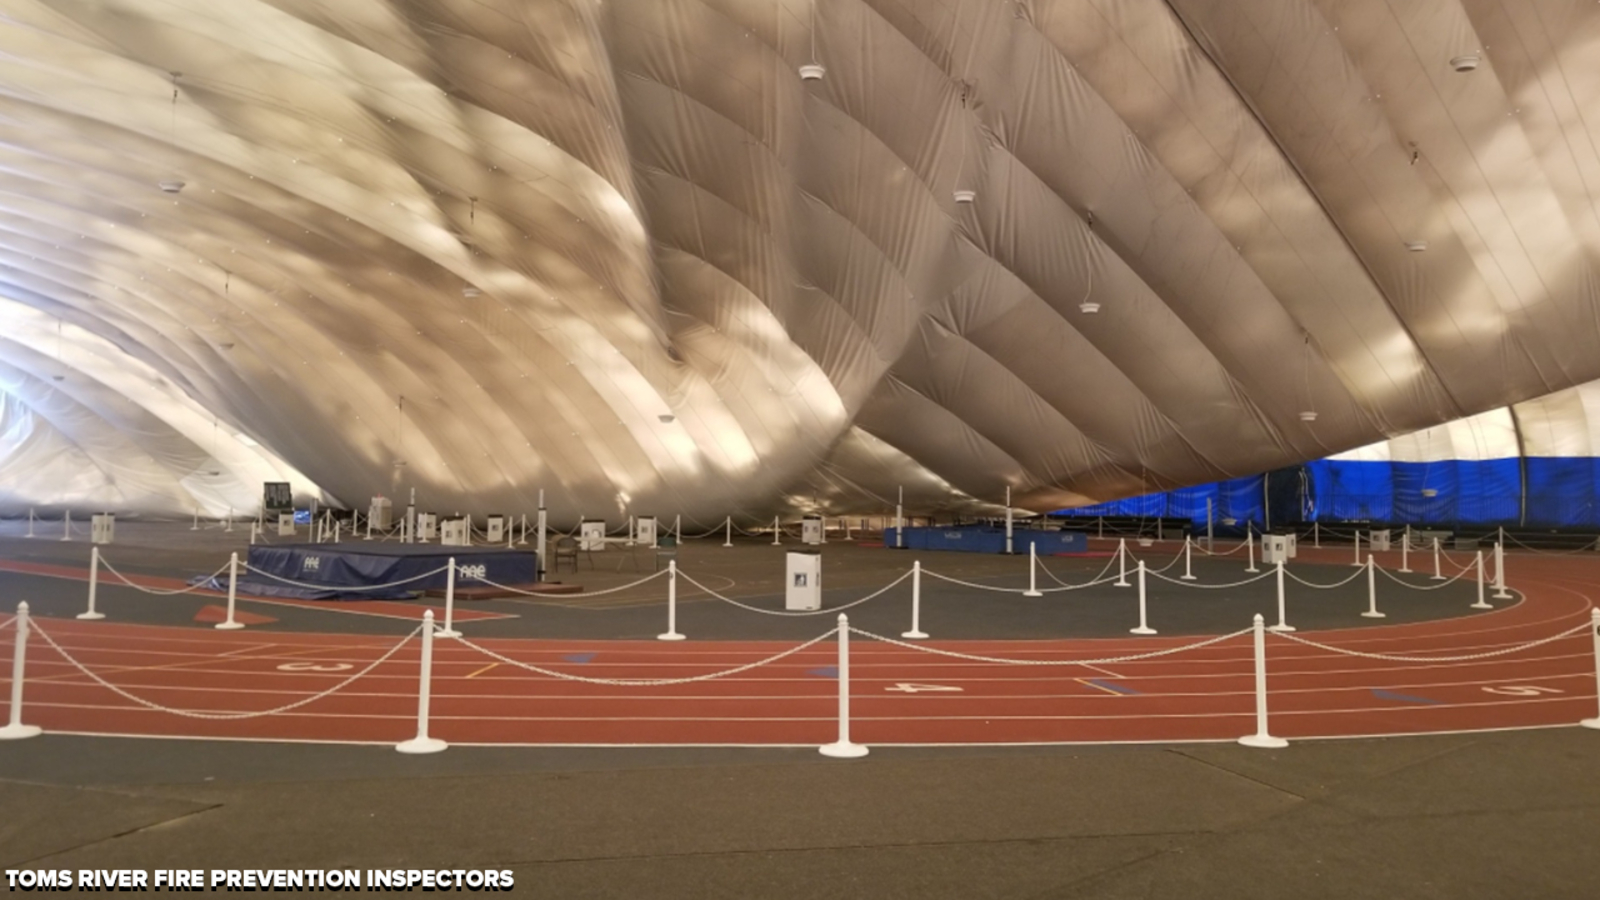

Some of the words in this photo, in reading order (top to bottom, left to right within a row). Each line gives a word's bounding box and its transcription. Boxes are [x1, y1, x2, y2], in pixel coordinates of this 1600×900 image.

[276, 662, 354, 671] 3
[884, 682, 964, 693] 4
[1481, 685, 1565, 696] 5
